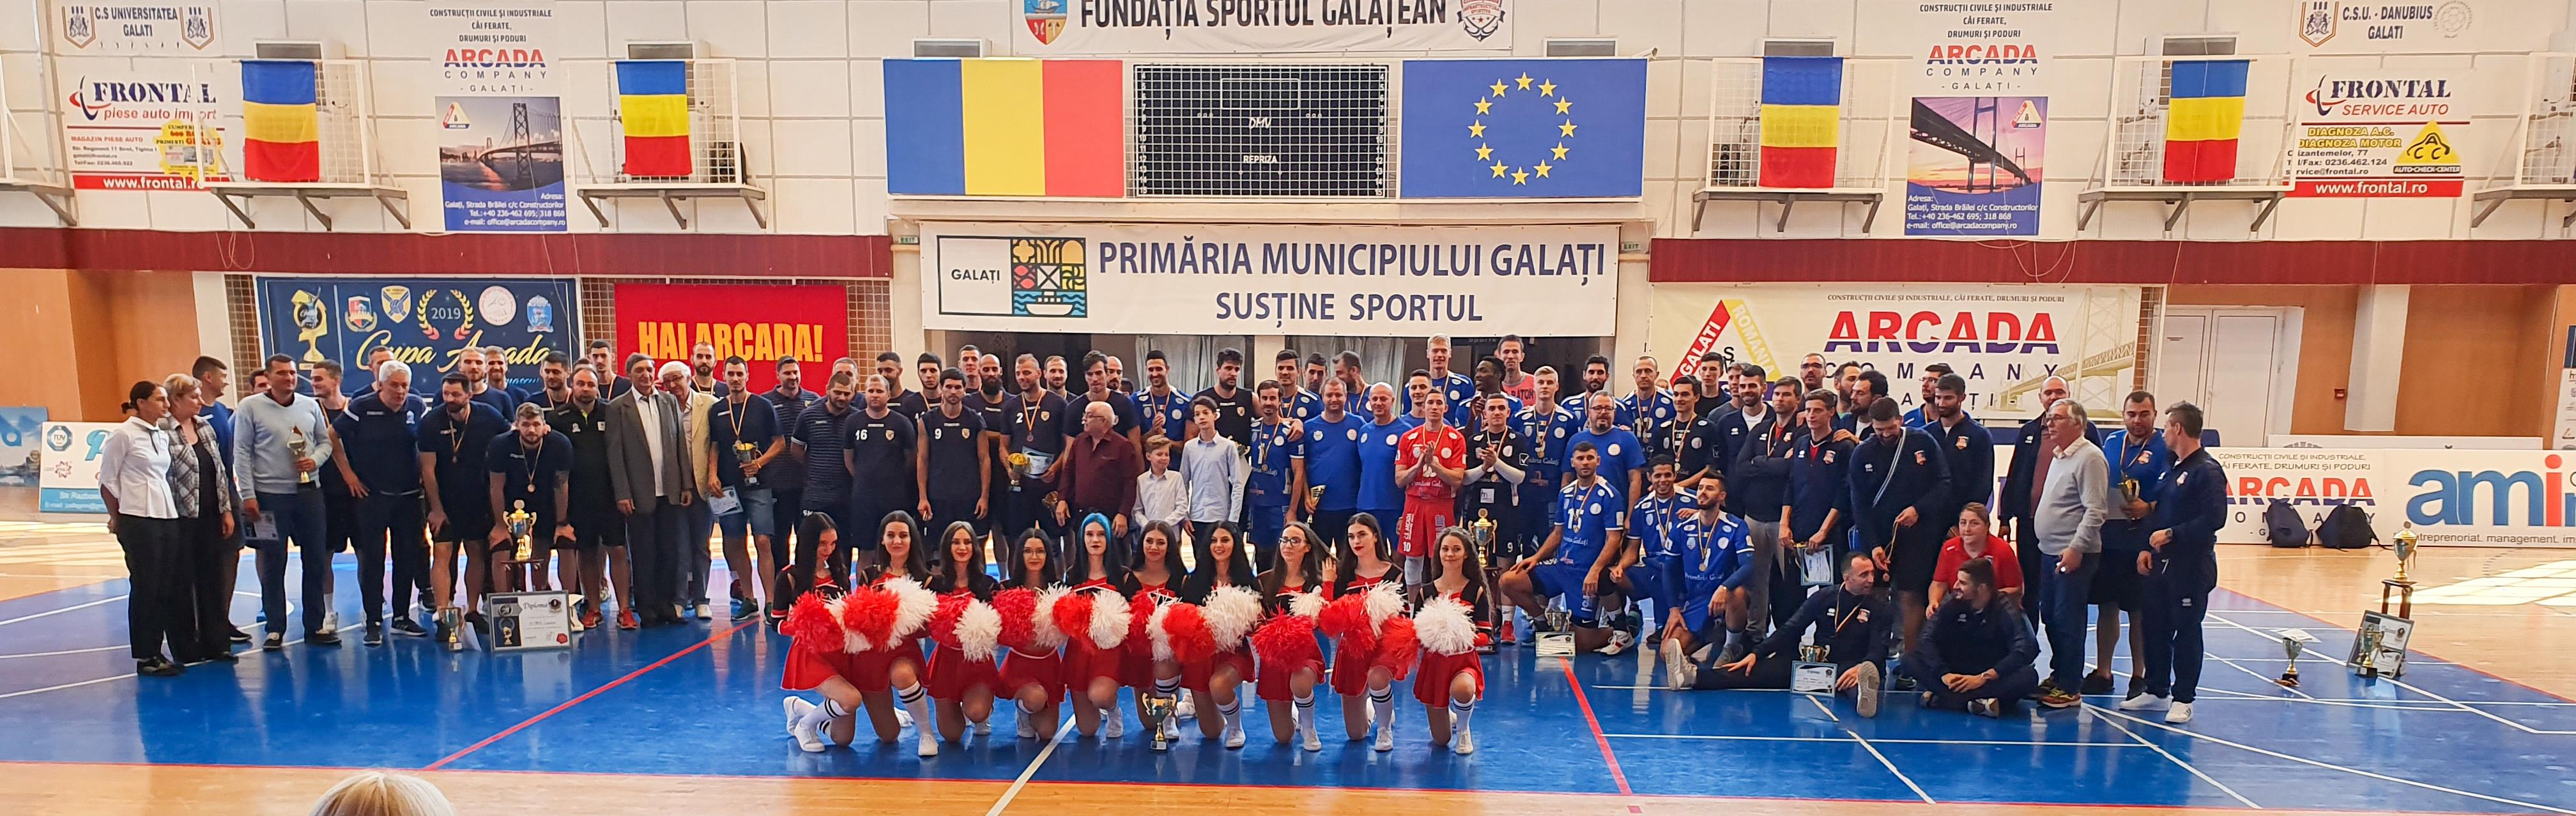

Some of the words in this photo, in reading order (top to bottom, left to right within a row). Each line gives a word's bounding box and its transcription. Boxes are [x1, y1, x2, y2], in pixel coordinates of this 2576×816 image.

[111, 7, 178, 20] UNIVERSITATEA
[1970, 4, 1993, 12] CIVILE
[2003, 3, 2053, 12] INDUSTRIALE
[2342, 7, 2372, 20] C.S.U.
[2380, 6, 2433, 20] DANUBIUS
[1081, 0, 1199, 40] FUNDAȚIA
[1206, 0, 1314, 27] SPORTUL
[1977, 17, 2007, 26] FERATE,
[123, 24, 153, 36] GALATI
[2368, 26, 2404, 40] GALATI
[444, 49, 546, 68] ARCADA
[1926, 45, 2038, 65] ARCADA
[445, 71, 547, 79] COMPANY
[1926, 67, 2037, 76] COMPANY
[2331, 80, 2451, 98] FRONTAL
[104, 107, 138, 120] piese
[142, 108, 170, 119] auto
[2342, 104, 2405, 116] SERVICE
[2407, 104, 2449, 116] AUTO
[2308, 127, 2368, 136] DIAGNOZA
[2370, 127, 2395, 136] A.C.
[2299, 139, 2357, 148] DIAGNOZA
[2359, 139, 2402, 148] MOTOR
[1243, 155, 1278, 164] REPRIZA
[103, 176, 205, 189] www.frontal.ro
[2315, 181, 2428, 194] www.frontal.ro
[1966, 213, 1982, 221] 695;
[1100, 235, 1253, 273] PRIMĂRIA
[1262, 243, 1481, 276] MUNICIPIULUI
[1491, 243, 1604, 286] GALAȚI
[951, 269, 1000, 284] GALAȚI
[431, 307, 461, 320] 2019
[1216, 292, 1335, 328] SUSȚINE
[1349, 293, 1482, 321] SPORTUL
[1823, 311, 2060, 355] ARCADA
[638, 321, 688, 360] HAI
[696, 323, 824, 363] ARCADA!
[1679, 321, 1722, 376] GALATI
[437, 330, 550, 373] Aada
[855, 429, 868, 440] 16
[935, 428, 942, 440] 9
[1403, 541, 1411, 552] 10
[1507, 542, 1514, 553] 9
